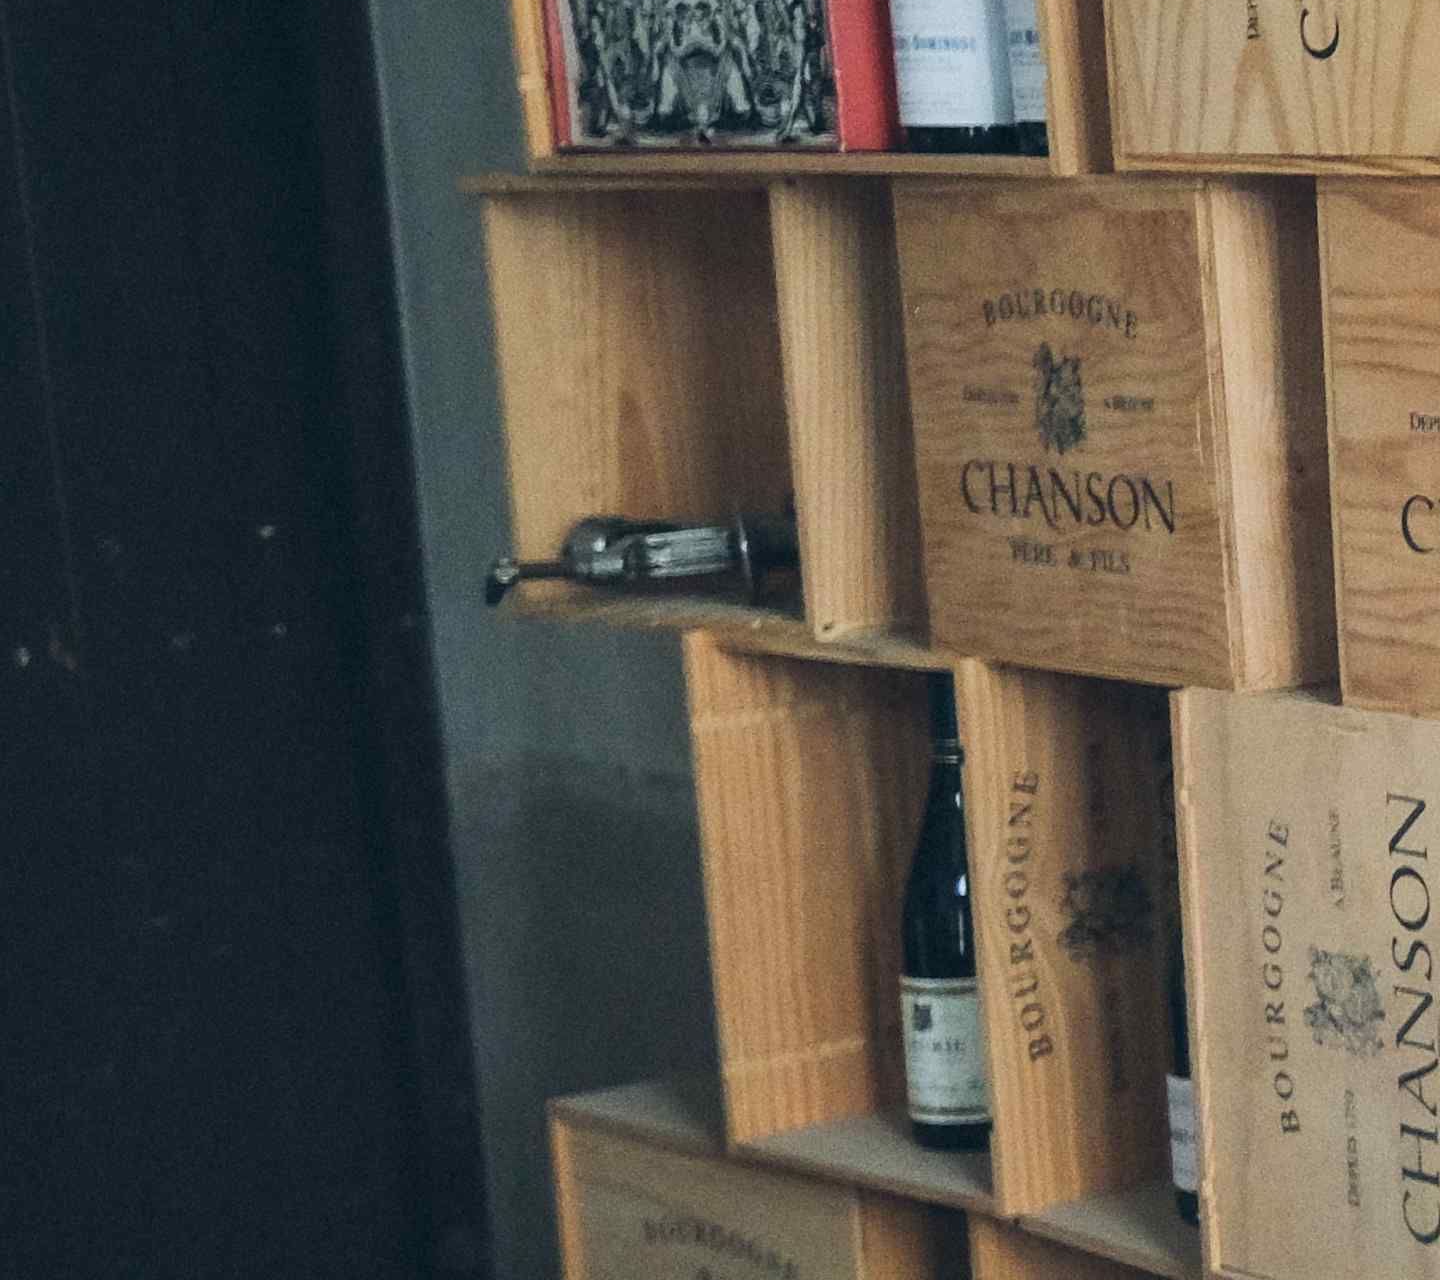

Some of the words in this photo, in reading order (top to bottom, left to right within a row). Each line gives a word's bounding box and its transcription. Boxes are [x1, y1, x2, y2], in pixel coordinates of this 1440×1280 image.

[982, 287, 1138, 340] BOURGOGNE
[961, 458, 1177, 534] CHANSON
[1004, 768, 1056, 1065] BOURGOGNE
[1261, 818, 1301, 1136] BOURGOGNE
